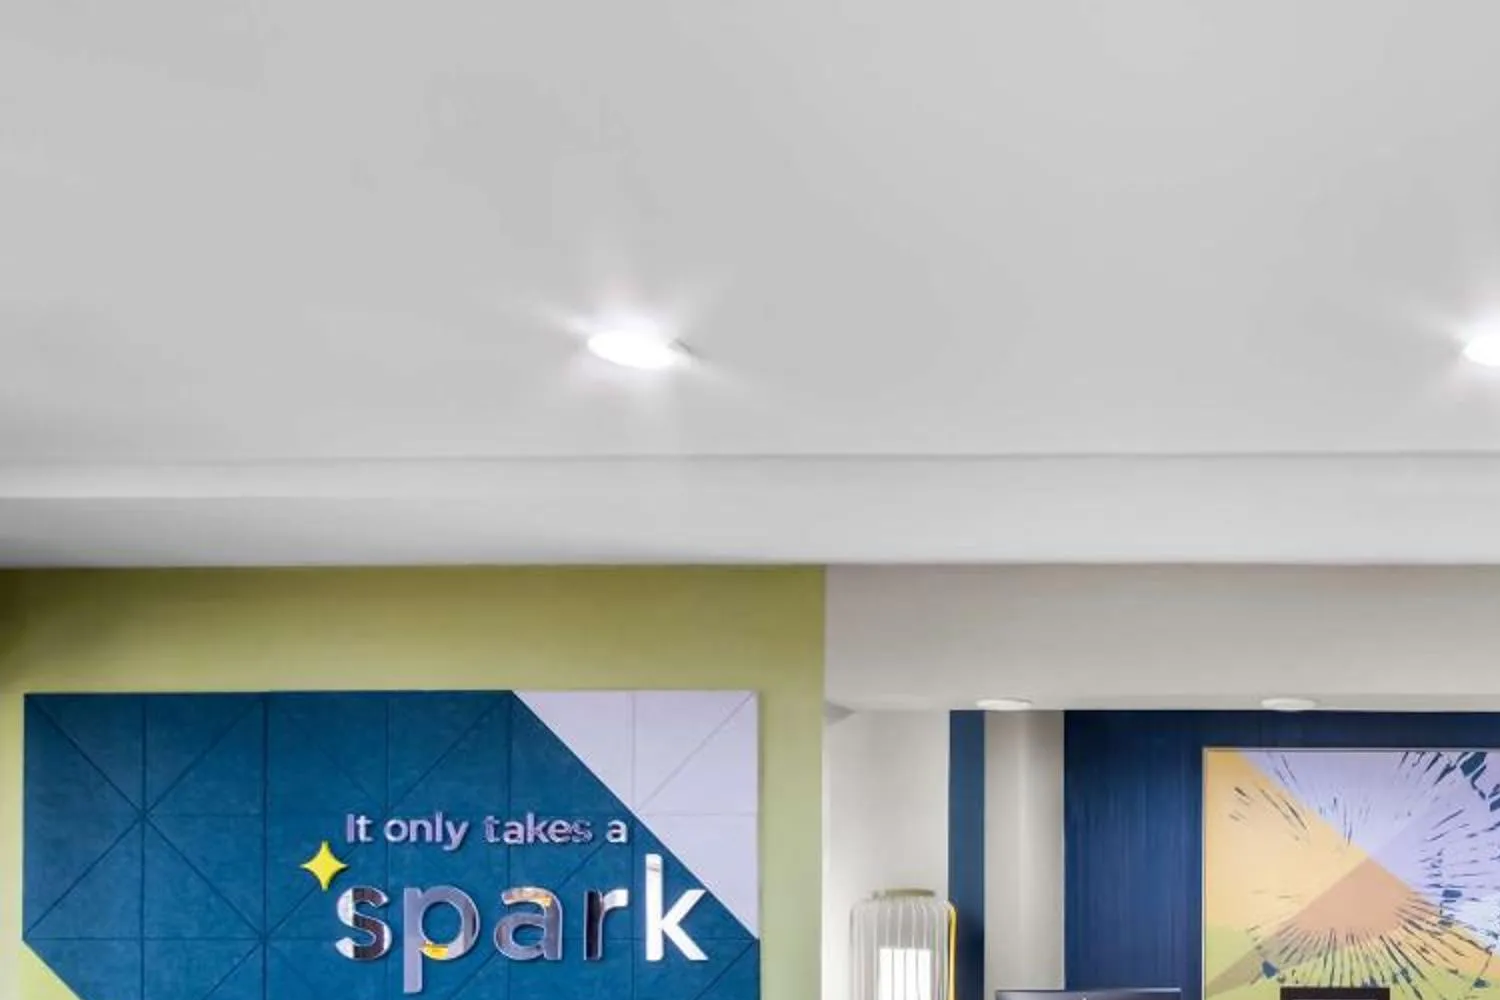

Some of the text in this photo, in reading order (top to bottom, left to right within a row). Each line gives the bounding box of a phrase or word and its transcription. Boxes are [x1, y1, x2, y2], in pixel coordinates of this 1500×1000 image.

[347, 811, 628, 851] It only takes a
[335, 853, 709, 994] spark
